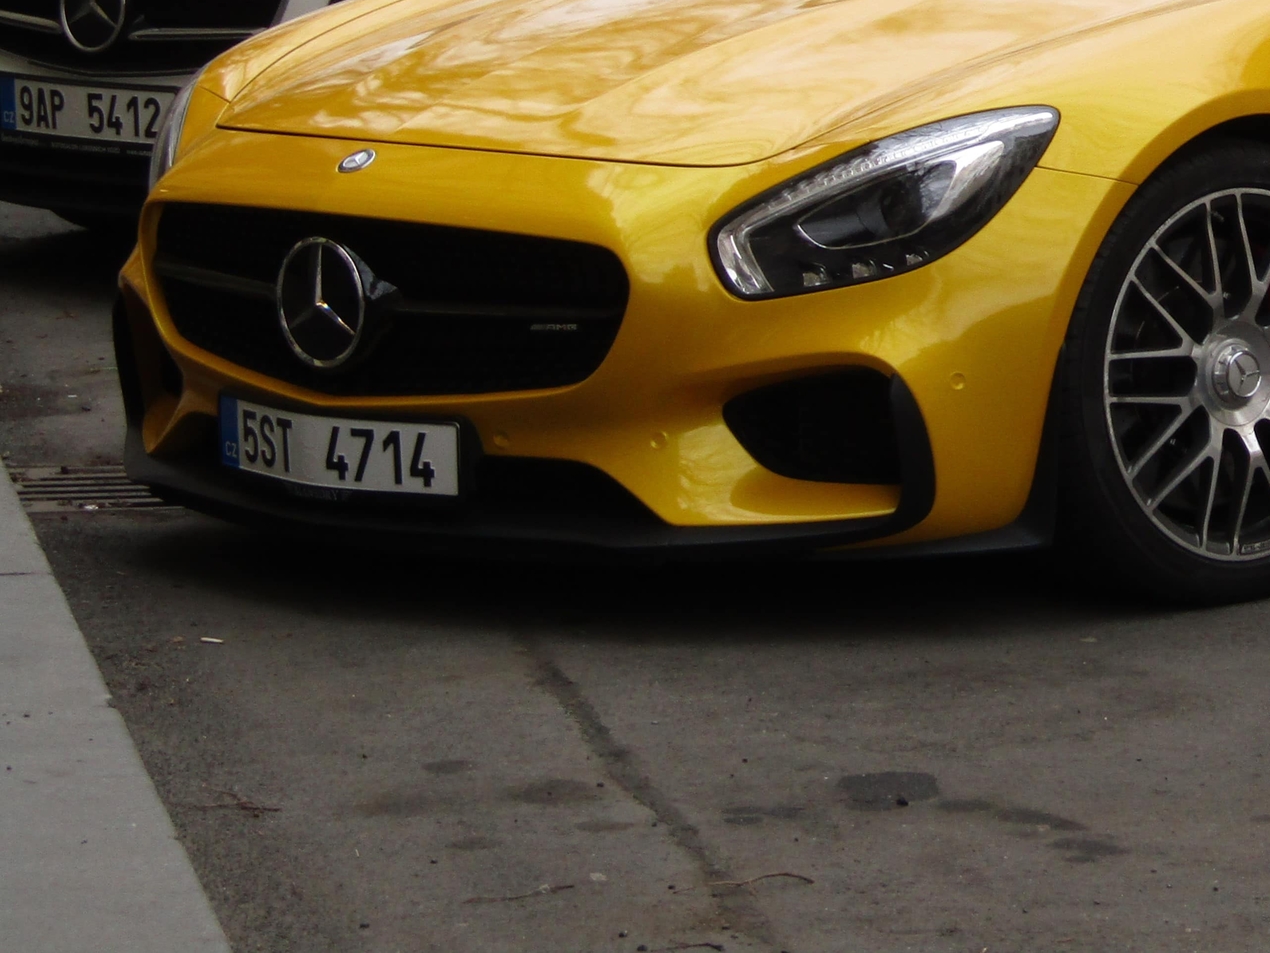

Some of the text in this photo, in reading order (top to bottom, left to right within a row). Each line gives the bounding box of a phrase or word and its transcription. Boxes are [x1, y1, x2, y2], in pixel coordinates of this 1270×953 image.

[3, 110, 16, 124] CZ
[20, 85, 161, 139] 9AP 5412
[225, 441, 238, 459] CZ
[242, 409, 436, 488] 5ST 4714
